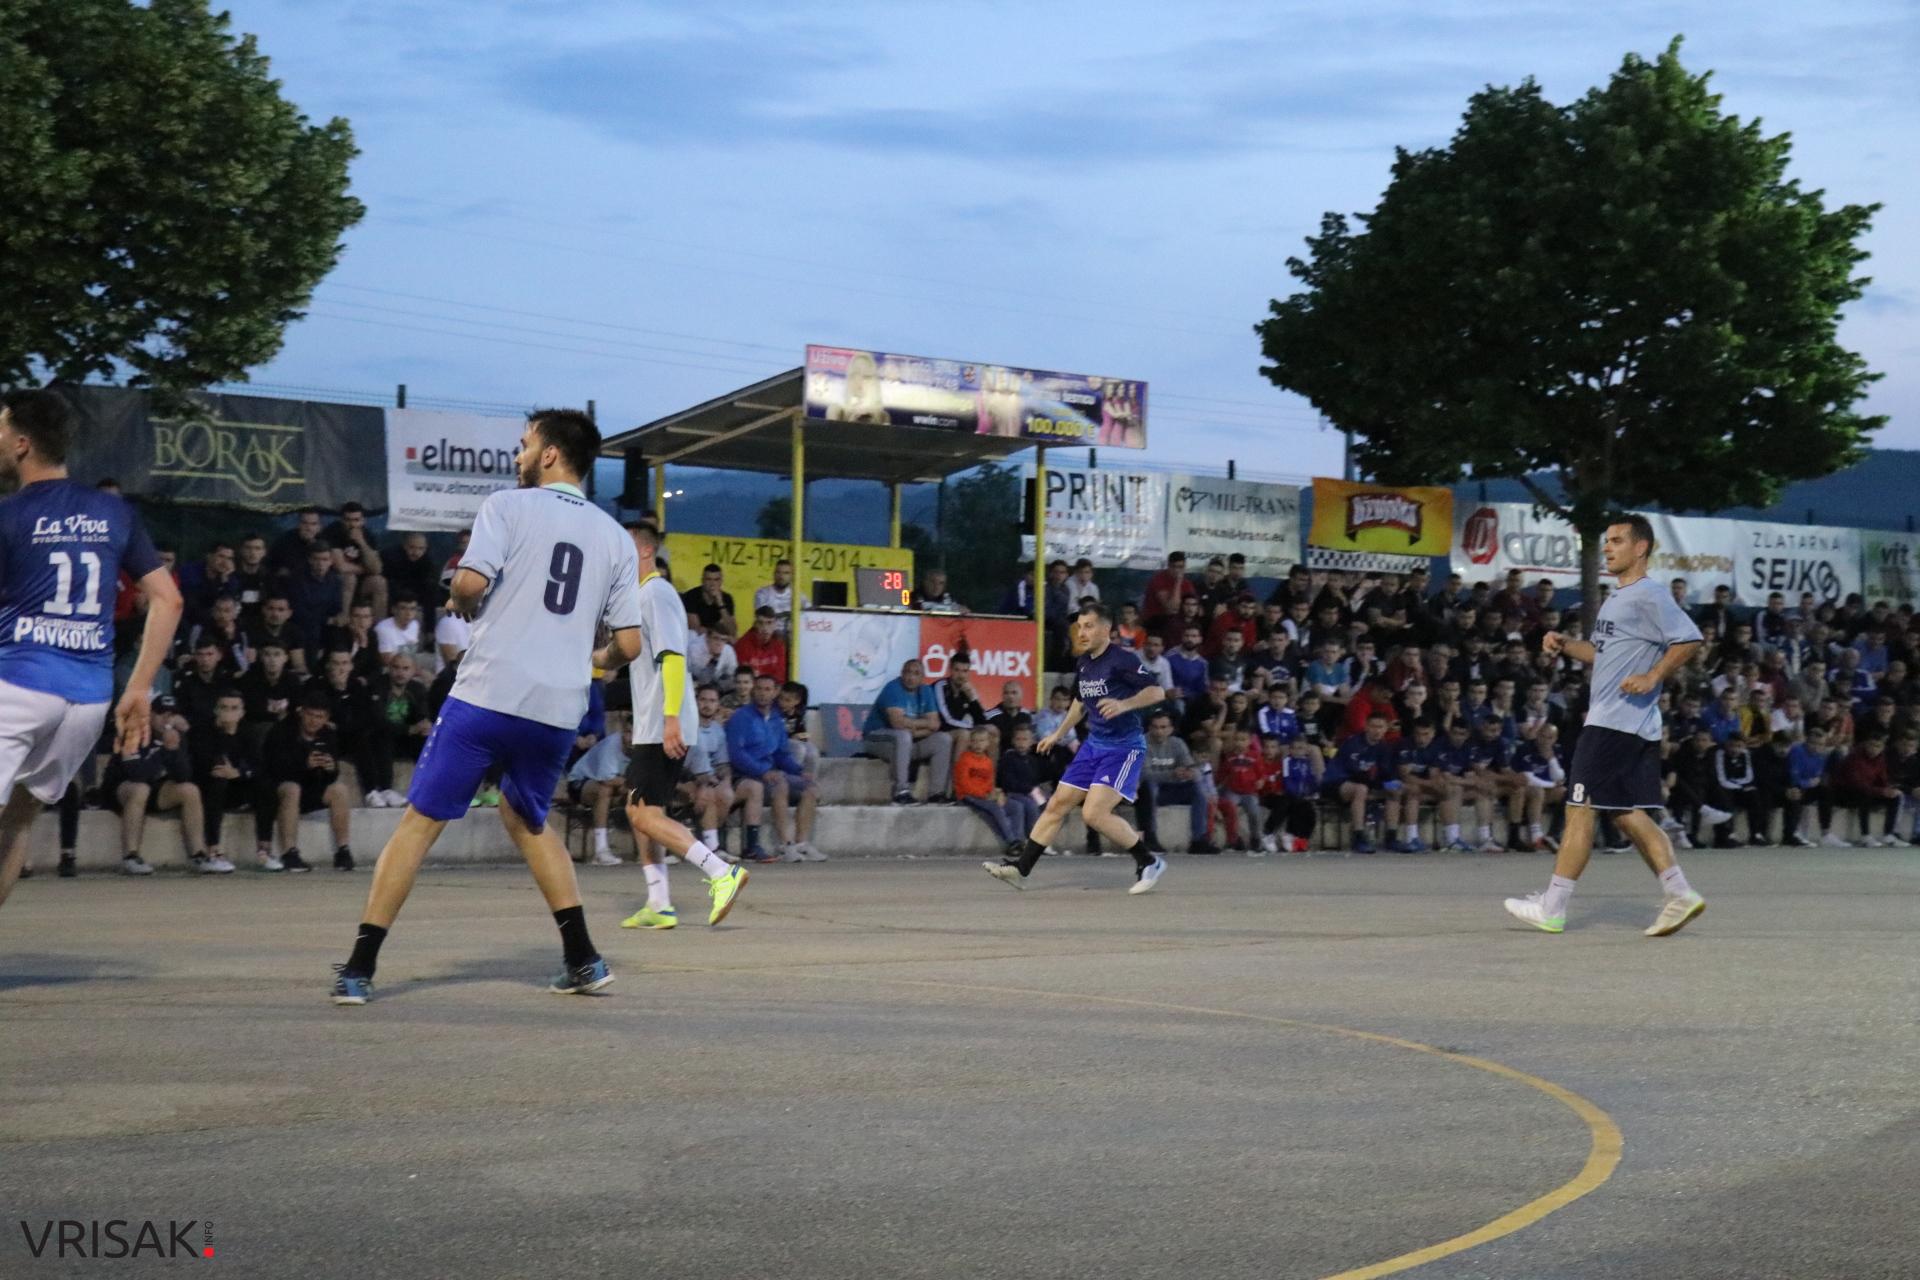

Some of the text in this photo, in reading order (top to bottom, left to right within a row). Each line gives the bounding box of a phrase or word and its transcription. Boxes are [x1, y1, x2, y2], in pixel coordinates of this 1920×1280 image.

[153, 420, 299, 486] BORAK
[1044, 469, 1148, 514] PRINT
[32, 513, 109, 535] La Viva
[1752, 532, 1841, 551] ZLATARNA
[42, 551, 102, 616] 11
[543, 541, 584, 616] 9
[1573, 783, 1585, 802] 8
